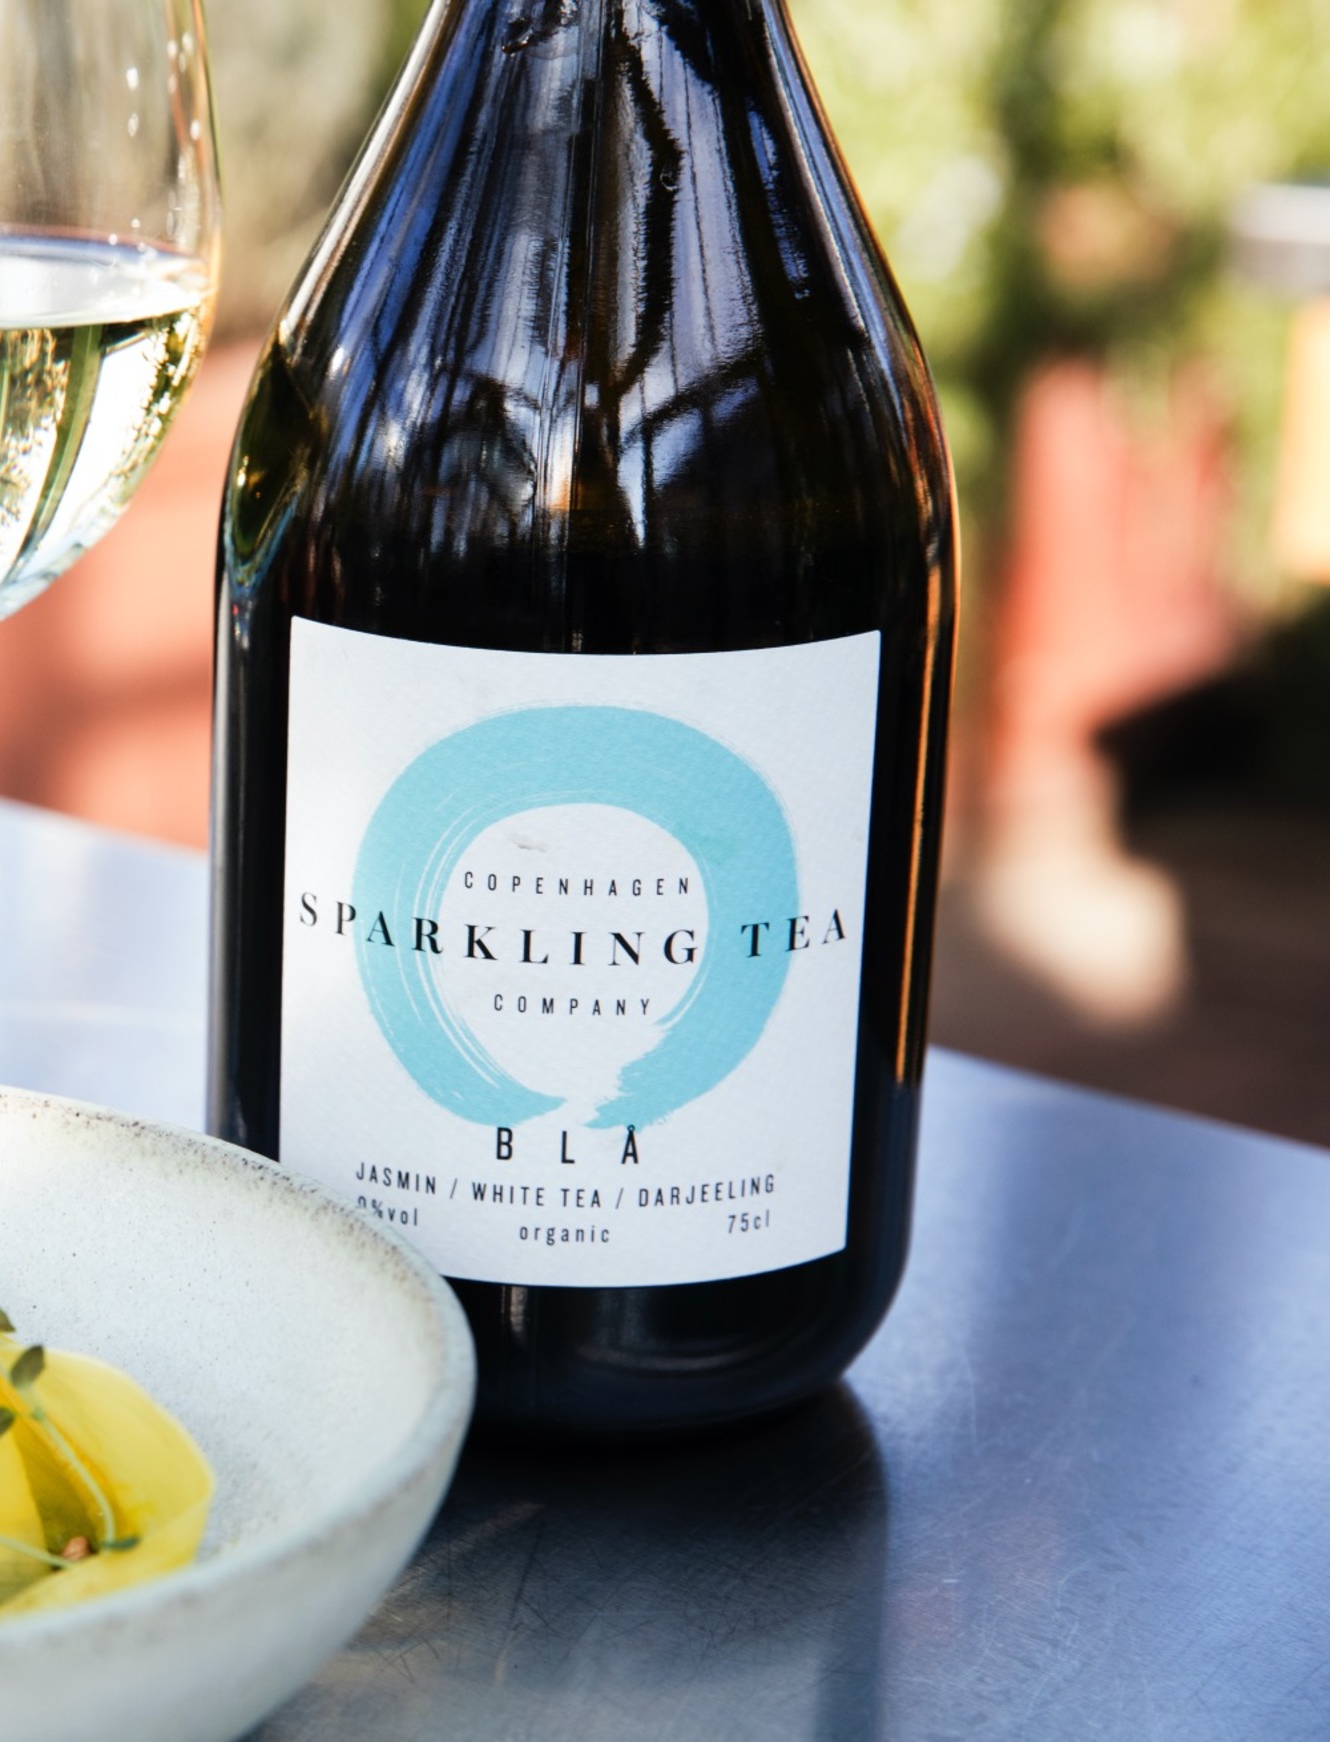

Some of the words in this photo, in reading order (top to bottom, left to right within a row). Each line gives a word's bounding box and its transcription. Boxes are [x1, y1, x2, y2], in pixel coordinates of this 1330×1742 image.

[463, 871, 690, 898] COPENHAGEN
[299, 891, 699, 967] SPARKLING
[739, 908, 847, 959] TEA
[493, 992, 651, 1016] COMPANY
[496, 1124, 641, 1166] BLÅ
[355, 1161, 437, 1196] JASMIN
[470, 1182, 546, 1208] WHITE
[560, 1187, 602, 1209] TEA
[637, 1173, 775, 1209] DARJEELING
[727, 1209, 771, 1235] 75cl
[519, 1225, 611, 1247] organic
